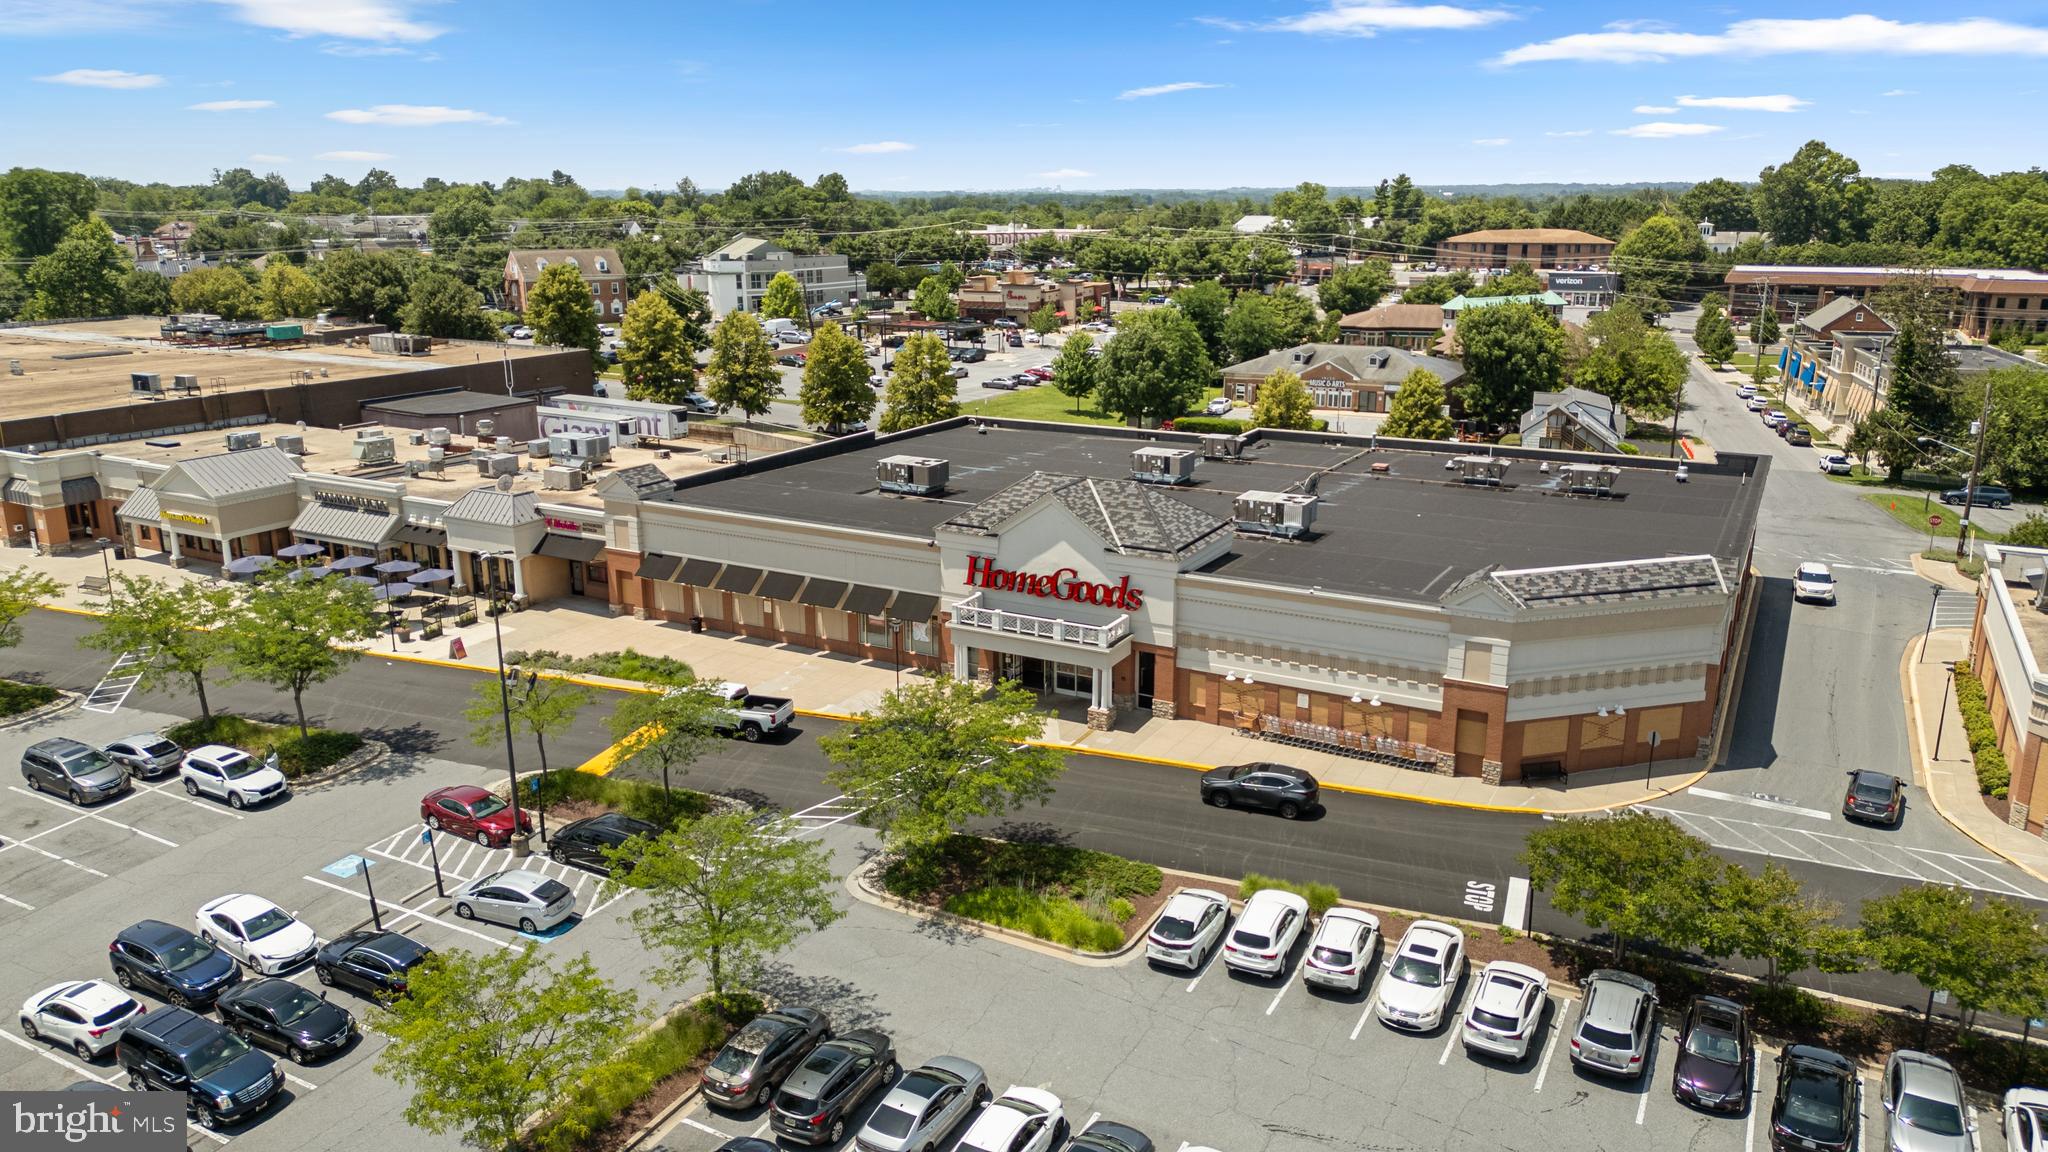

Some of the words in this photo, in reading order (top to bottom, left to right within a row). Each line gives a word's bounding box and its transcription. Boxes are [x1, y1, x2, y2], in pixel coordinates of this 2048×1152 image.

[1555, 277, 1583, 285] verizon
[1309, 379, 1326, 387] MUSIC
[963, 554, 1144, 612] HomeGoods
[1464, 881, 1495, 911] STOP
